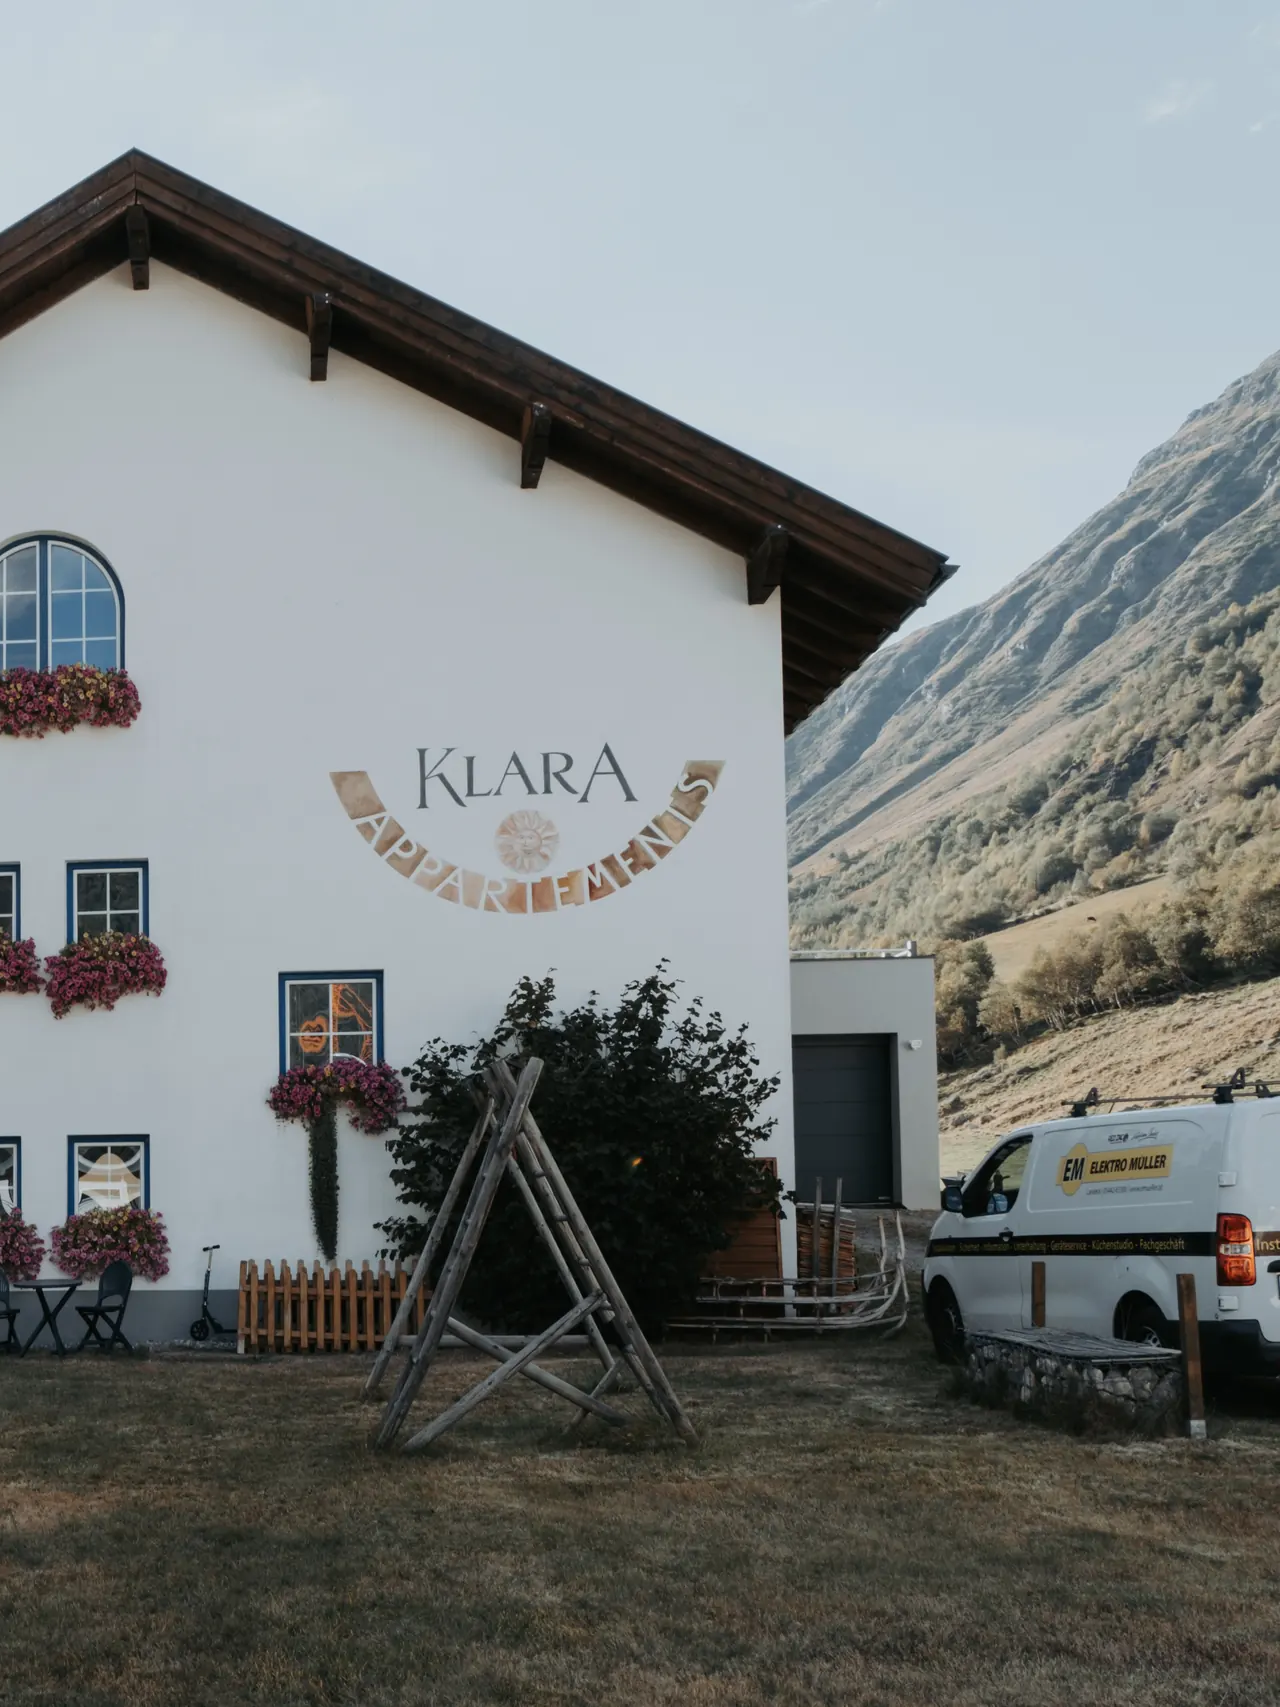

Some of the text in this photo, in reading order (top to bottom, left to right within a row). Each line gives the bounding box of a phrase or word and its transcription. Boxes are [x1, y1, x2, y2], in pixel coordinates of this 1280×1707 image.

[416, 742, 639, 809] KLARA
[352, 772, 715, 915] APPARTEMENTS
[1063, 1157, 1085, 1182] EM
[1089, 1158, 1128, 1175] ELEKTRO
[1139, 1237, 1185, 1253] Fachgeschäft
